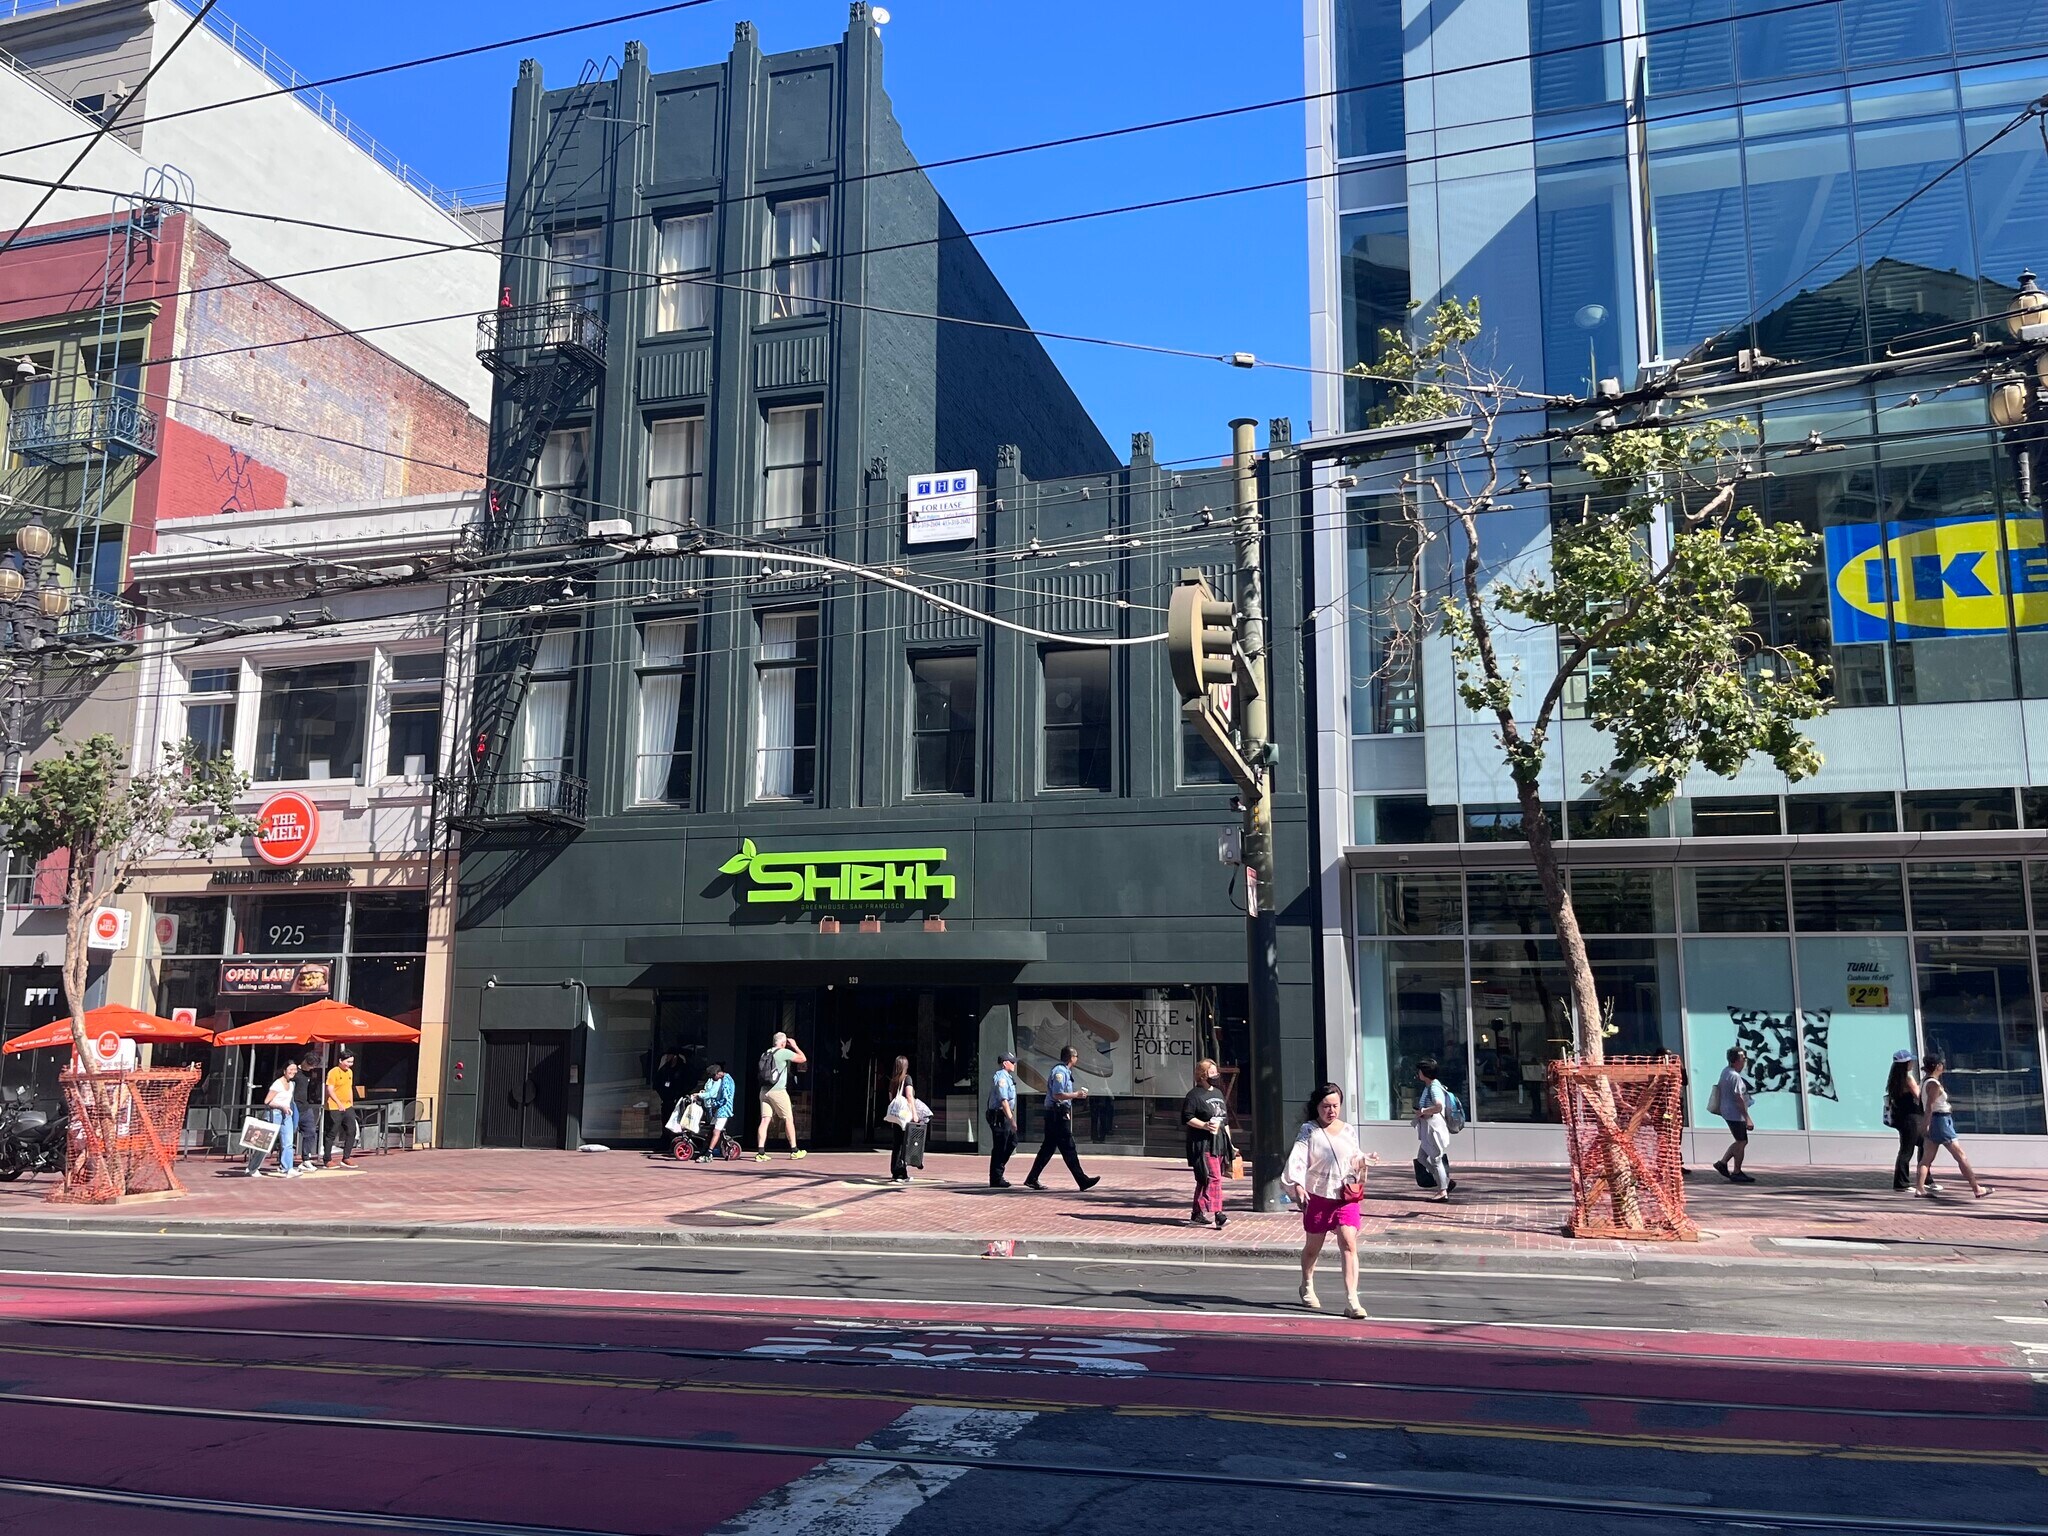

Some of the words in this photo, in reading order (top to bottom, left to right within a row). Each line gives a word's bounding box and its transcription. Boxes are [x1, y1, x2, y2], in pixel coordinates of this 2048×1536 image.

[922, 503, 938, 512] FOR
[940, 502, 962, 510] LEASE
[271, 812, 297, 825] THE
[262, 825, 305, 842] MELT
[269, 925, 305, 945] 925
[225, 967, 260, 982] OPEN
[261, 967, 296, 982] LATE!
[1847, 962, 1879, 972] TURILL
[238, 983, 258, 991] Melting
[1134, 1009, 1179, 1025] NIKE
[1134, 1025, 1169, 1040] AIR
[1134, 1039, 1193, 1056] FORCE
[1134, 1054, 1142, 1070] 1
